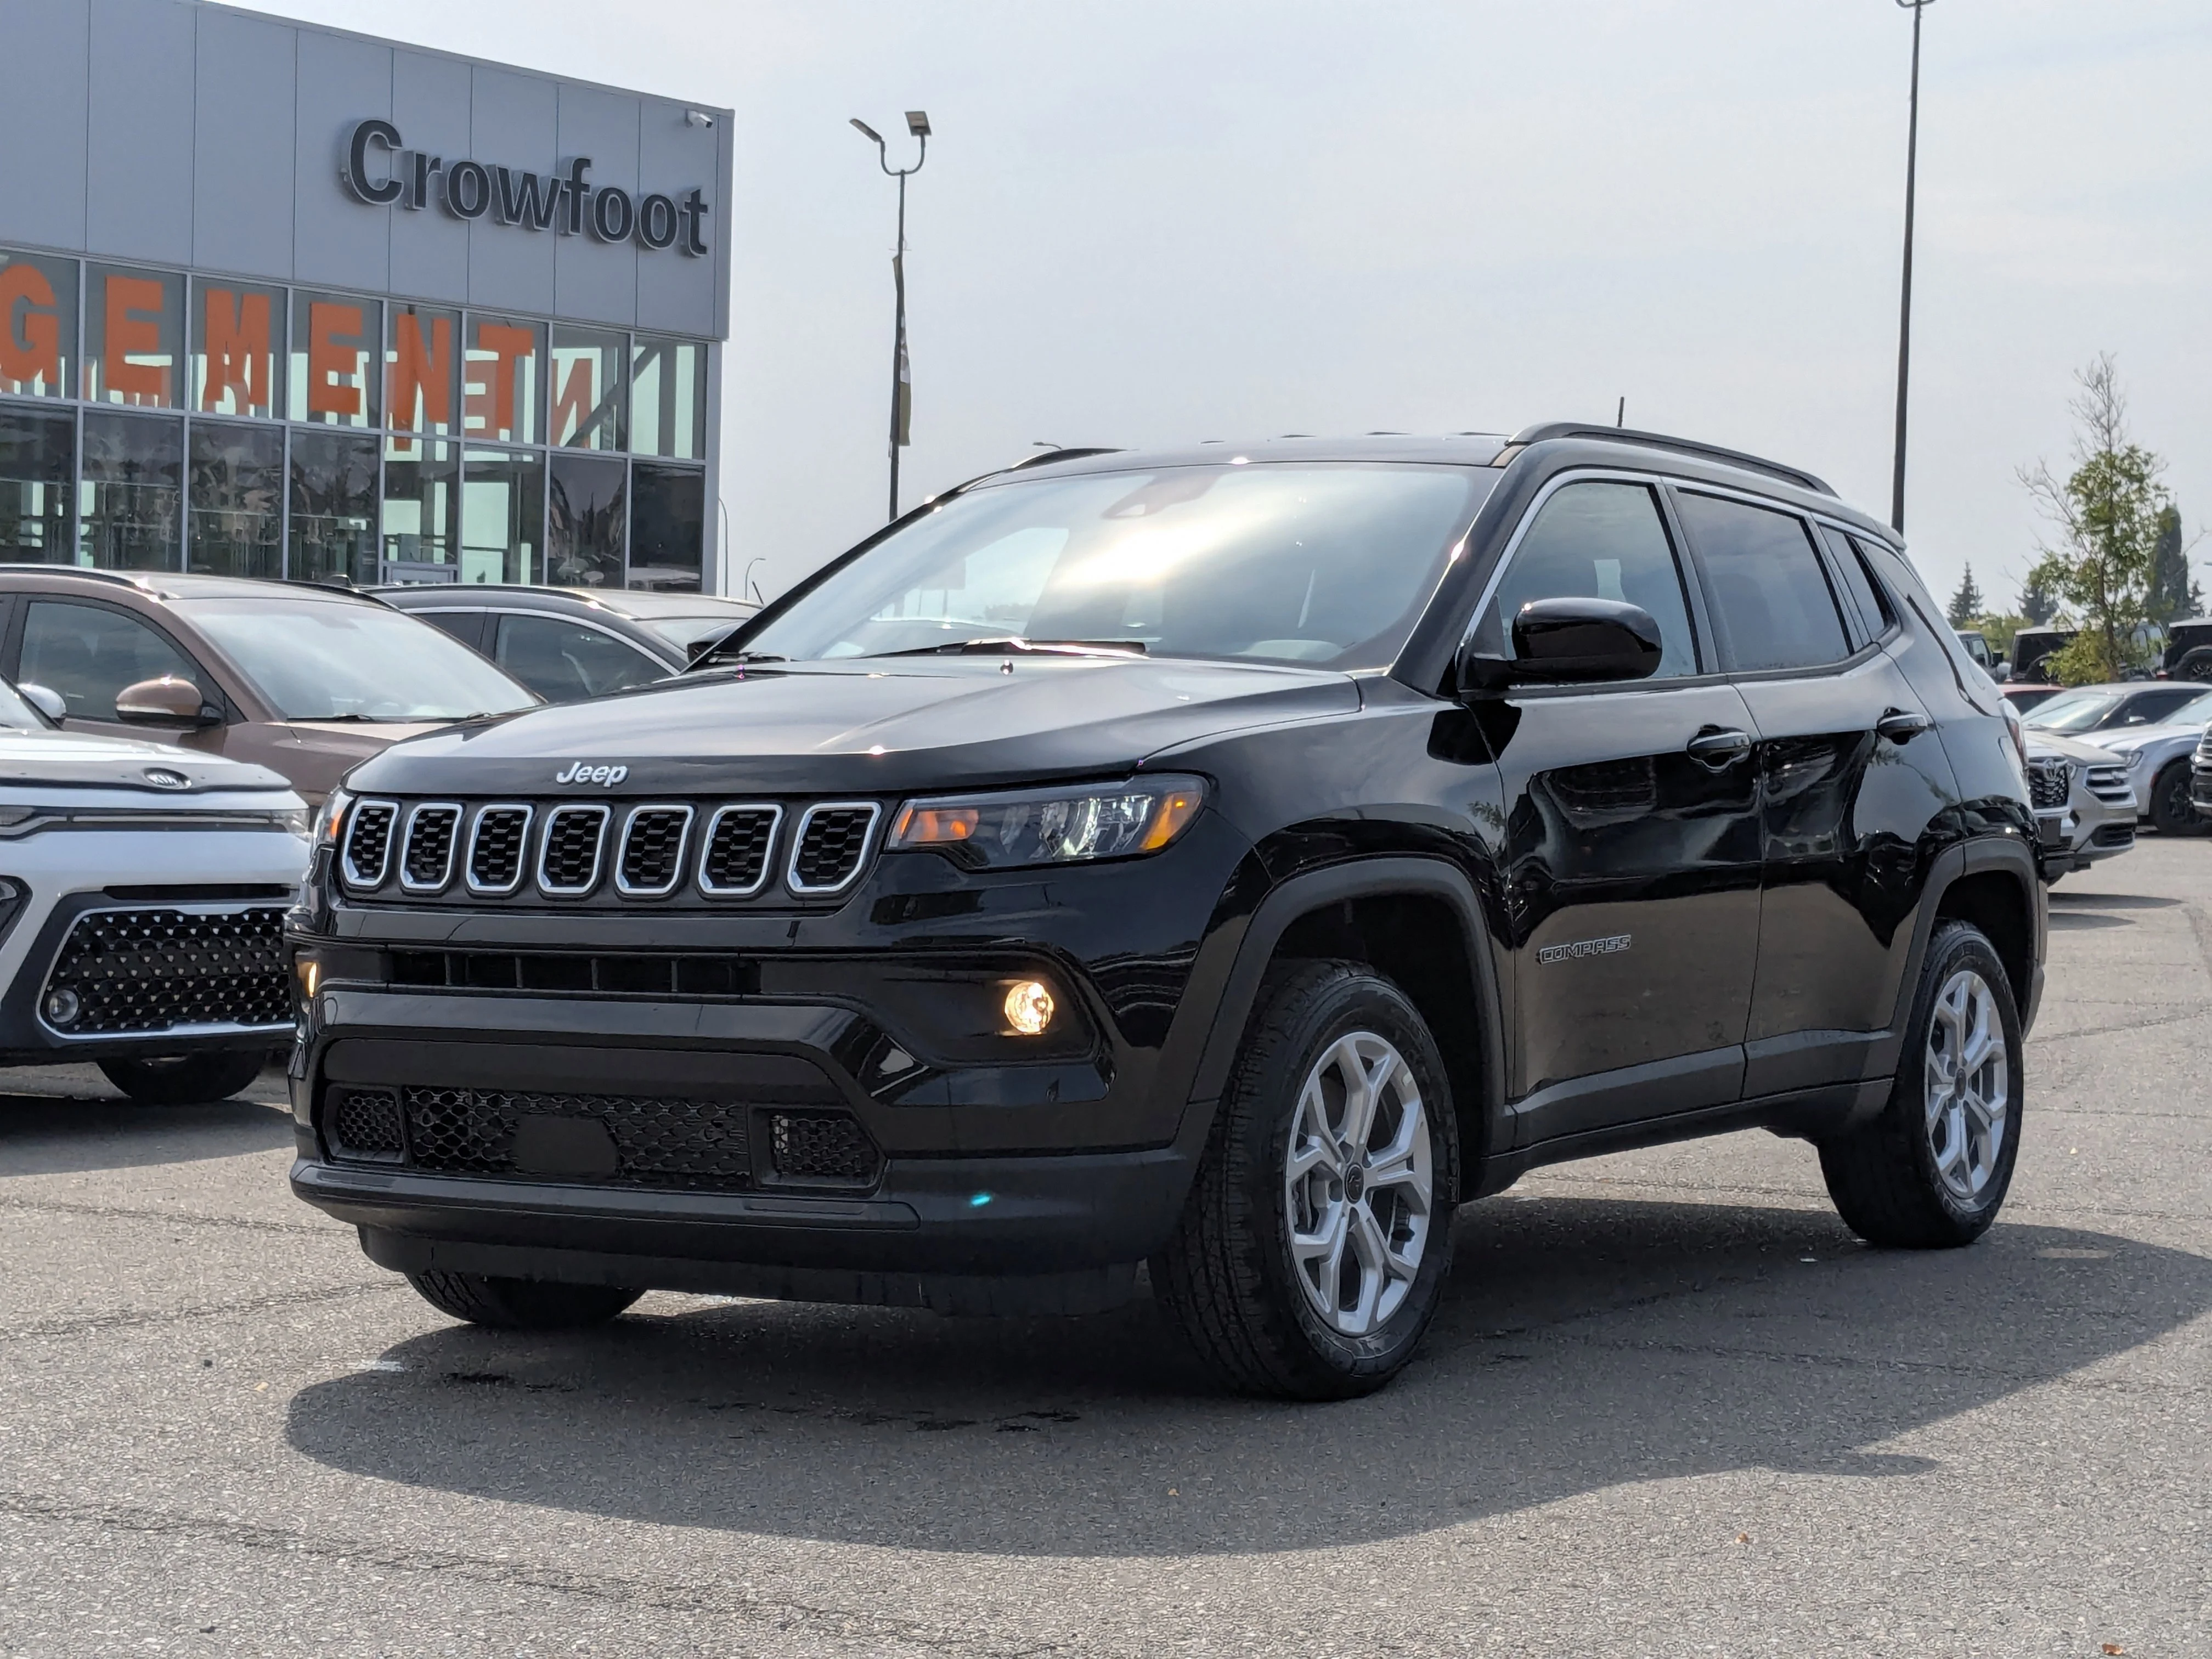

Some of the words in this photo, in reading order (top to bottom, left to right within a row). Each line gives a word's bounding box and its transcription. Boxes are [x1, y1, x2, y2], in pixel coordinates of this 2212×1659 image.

[347, 119, 709, 257] Crowfoot
[556, 761, 628, 788] Jeep
[1540, 935, 1631, 964] COMPASS
